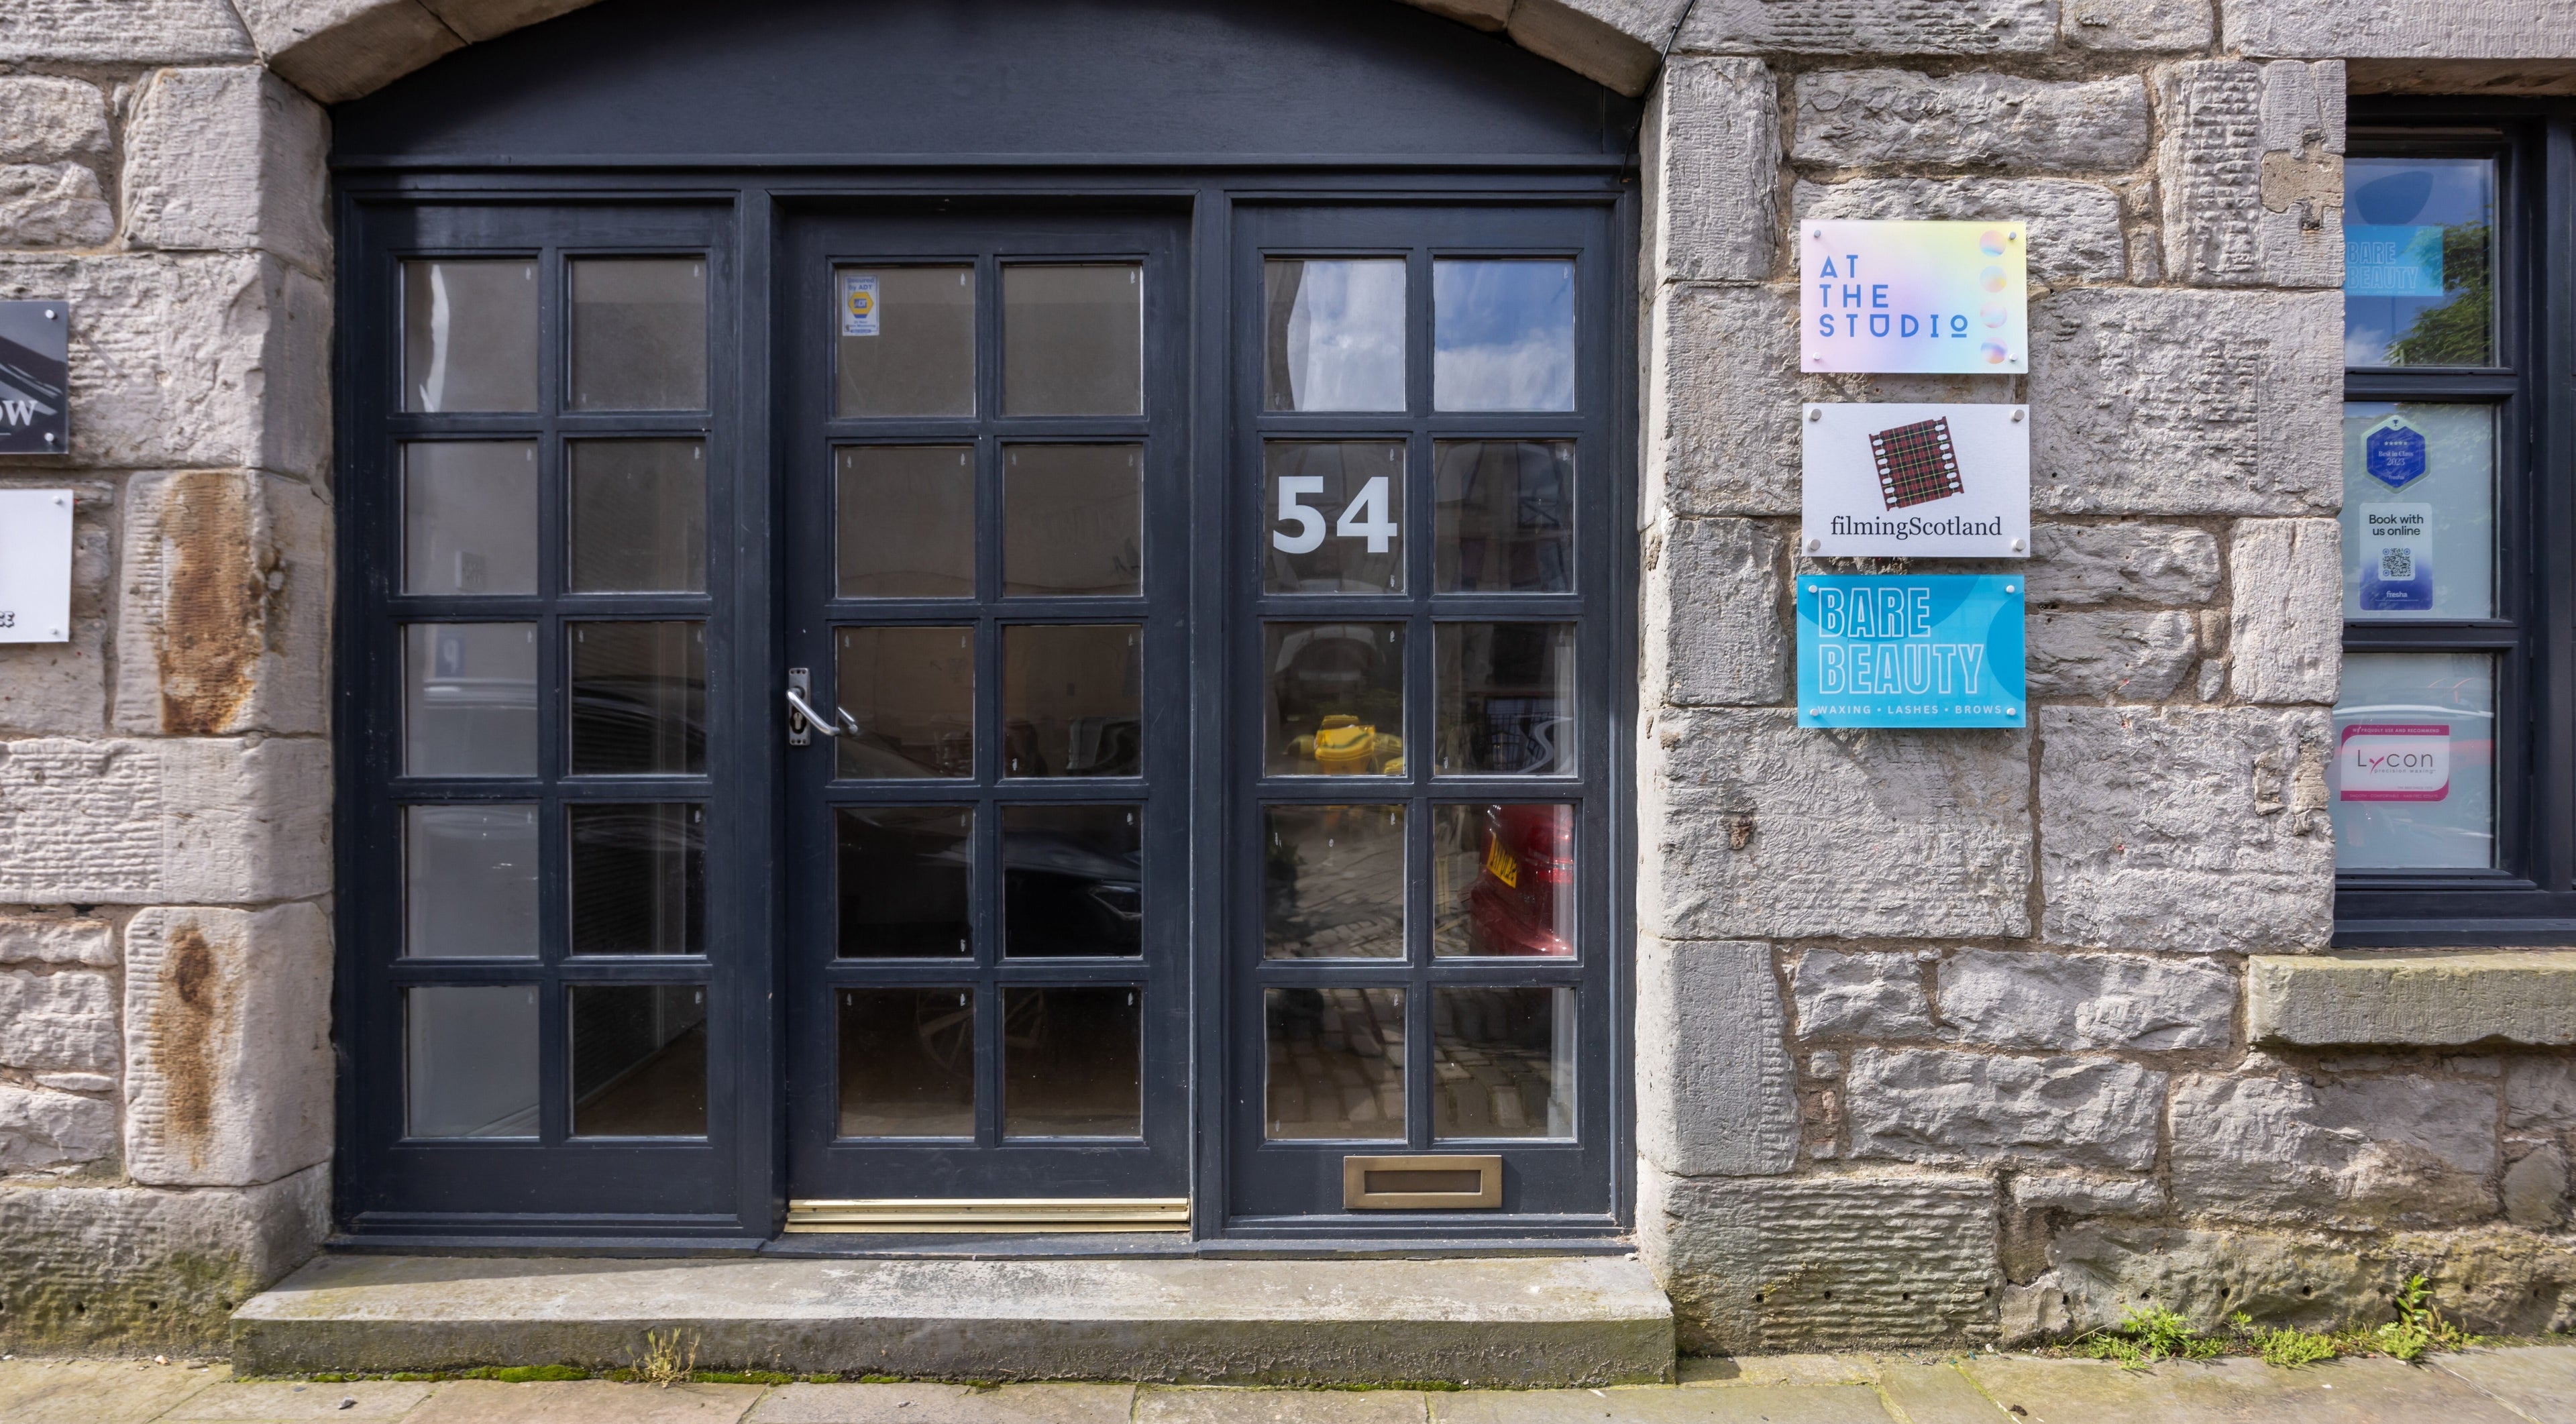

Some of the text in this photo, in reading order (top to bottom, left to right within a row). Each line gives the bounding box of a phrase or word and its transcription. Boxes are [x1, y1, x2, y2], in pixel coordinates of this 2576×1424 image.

[2347, 241, 2396, 264] BARE
[1819, 255, 1859, 278] AT
[2347, 266, 2419, 289] BEAUTY
[1819, 284, 1889, 308] THE
[1819, 314, 1969, 338] STUDIO
[2386, 457, 2406, 466] 2023
[1273, 476, 1397, 554] 54
[2369, 514, 2424, 524] Book with
[1831, 516, 2002, 540] filmingScotland
[2372, 525, 2420, 536] us online
[1818, 588, 1931, 638] BARE
[1819, 644, 1984, 694] BEAUTY
[1817, 705, 2002, 714] WAXING LASHES BROWS
